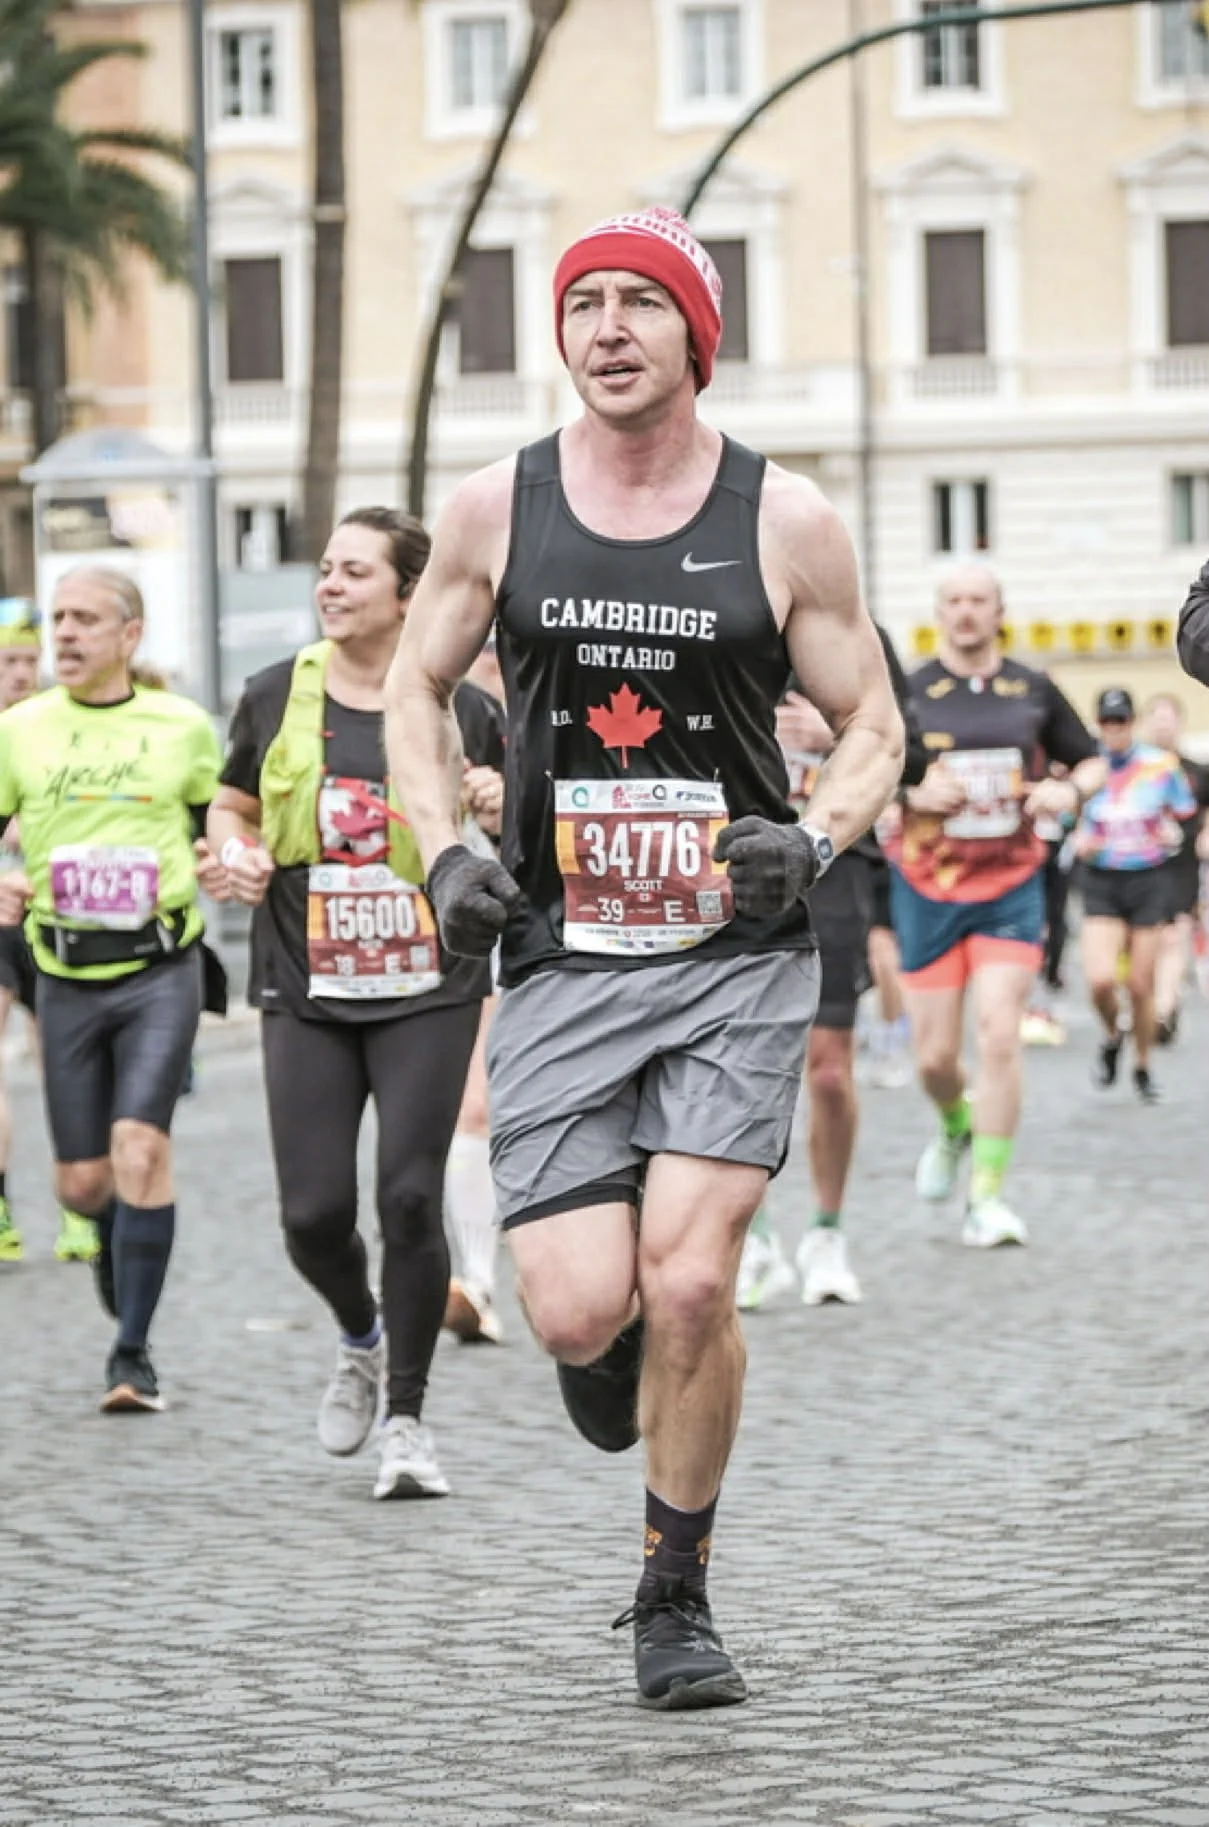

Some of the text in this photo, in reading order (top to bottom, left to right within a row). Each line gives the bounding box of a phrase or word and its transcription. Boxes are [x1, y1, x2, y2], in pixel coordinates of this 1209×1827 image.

[541, 598, 717, 640] CAMBRIDGE
[577, 643, 676, 671] ONTARIO
[582, 820, 701, 878] 34776
[623, 879, 663, 892] SCOTT
[325, 894, 418, 941] 15600
[597, 897, 625, 923] 39
[663, 901, 686, 923] E
